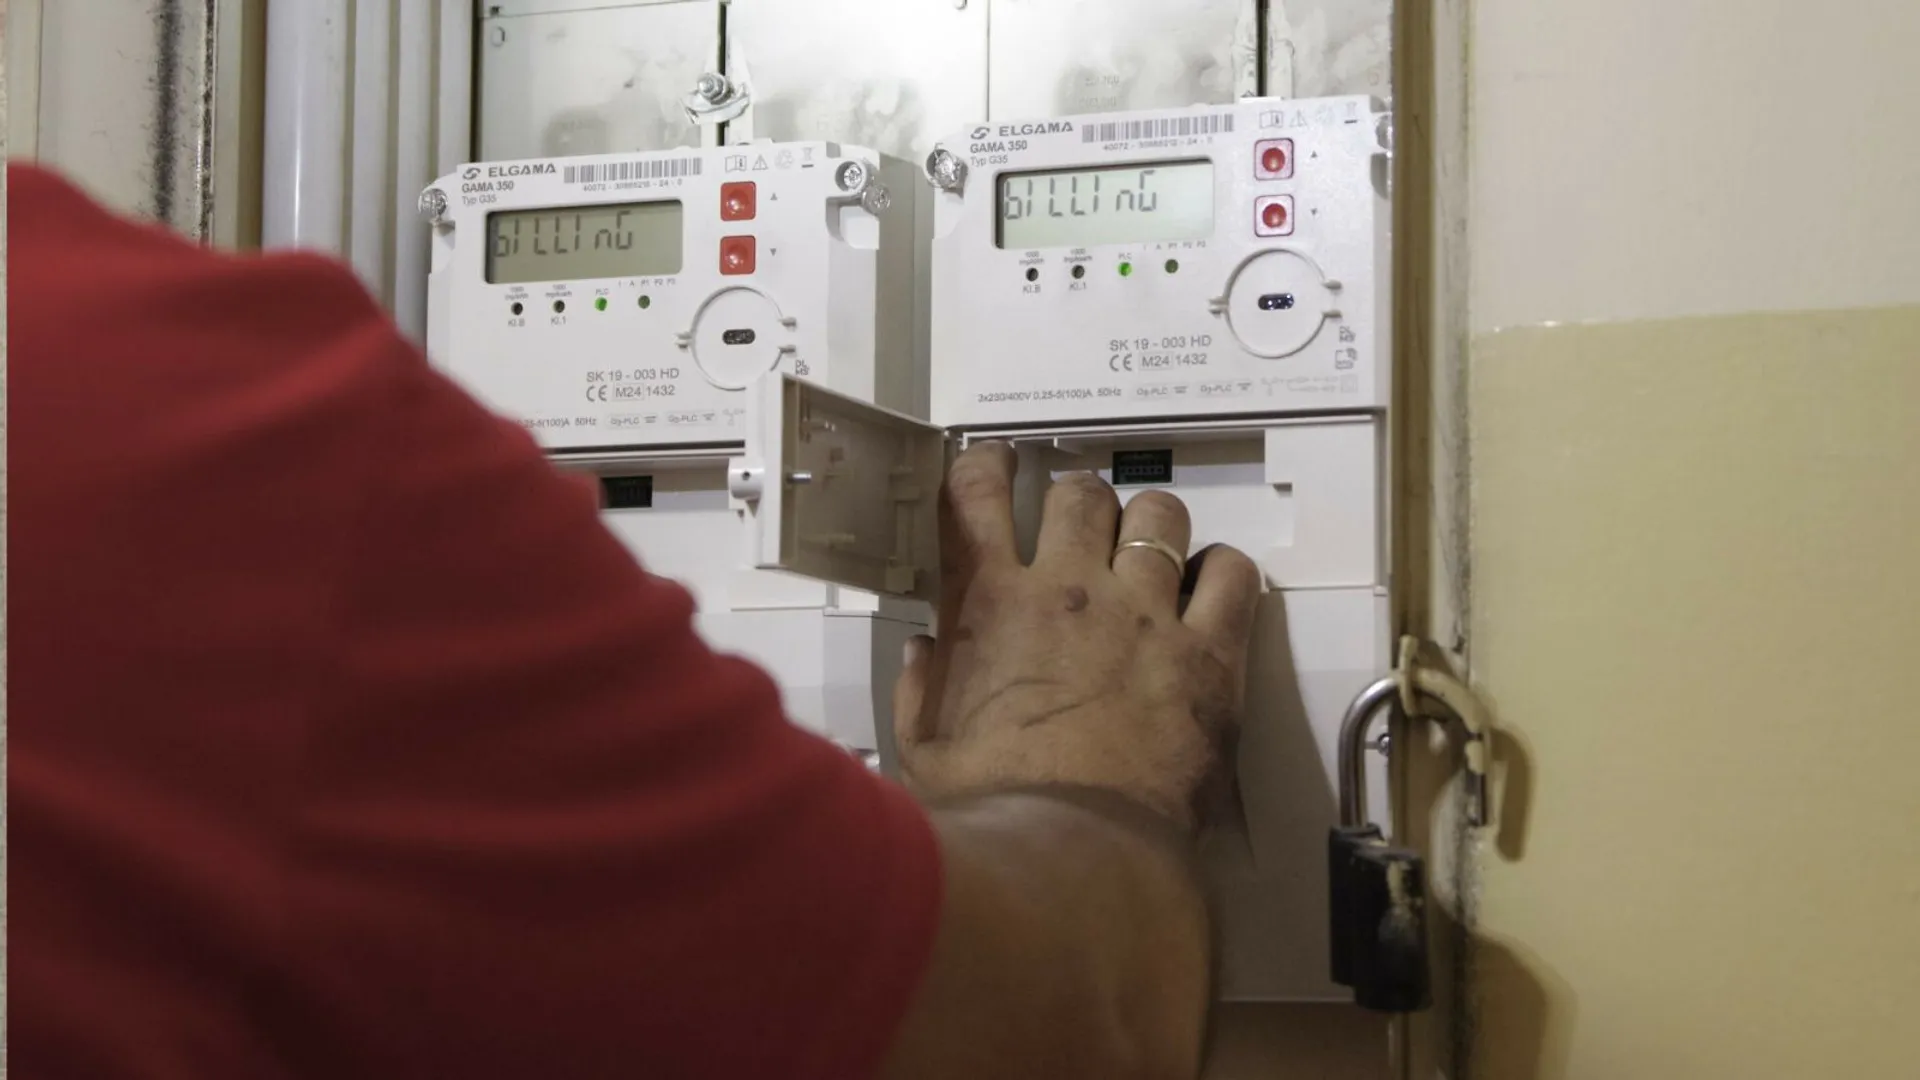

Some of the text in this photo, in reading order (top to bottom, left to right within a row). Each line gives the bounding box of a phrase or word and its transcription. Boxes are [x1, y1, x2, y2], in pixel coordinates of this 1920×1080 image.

[999, 121, 1074, 137] ELGAMA
[970, 139, 1028, 154] GAMA 350
[970, 154, 1008, 168] Typ G35
[488, 163, 556, 178] ELGAMA
[462, 180, 515, 194] GAMA 350
[462, 193, 498, 207] Typ G35
[1109, 339, 1129, 351] SK
[1134, 337, 1150, 350] 19
[1161, 336, 1186, 349] 003
[1190, 334, 1212, 347] HD
[1109, 352, 1207, 372] CE M24 1432
[586, 370, 605, 383] SK
[608, 369, 622, 382] 19
[633, 368, 657, 381] 003
[660, 367, 680, 379] HD
[586, 384, 676, 402] CE M24 1432
[1096, 387, 1122, 397] 50Hz
